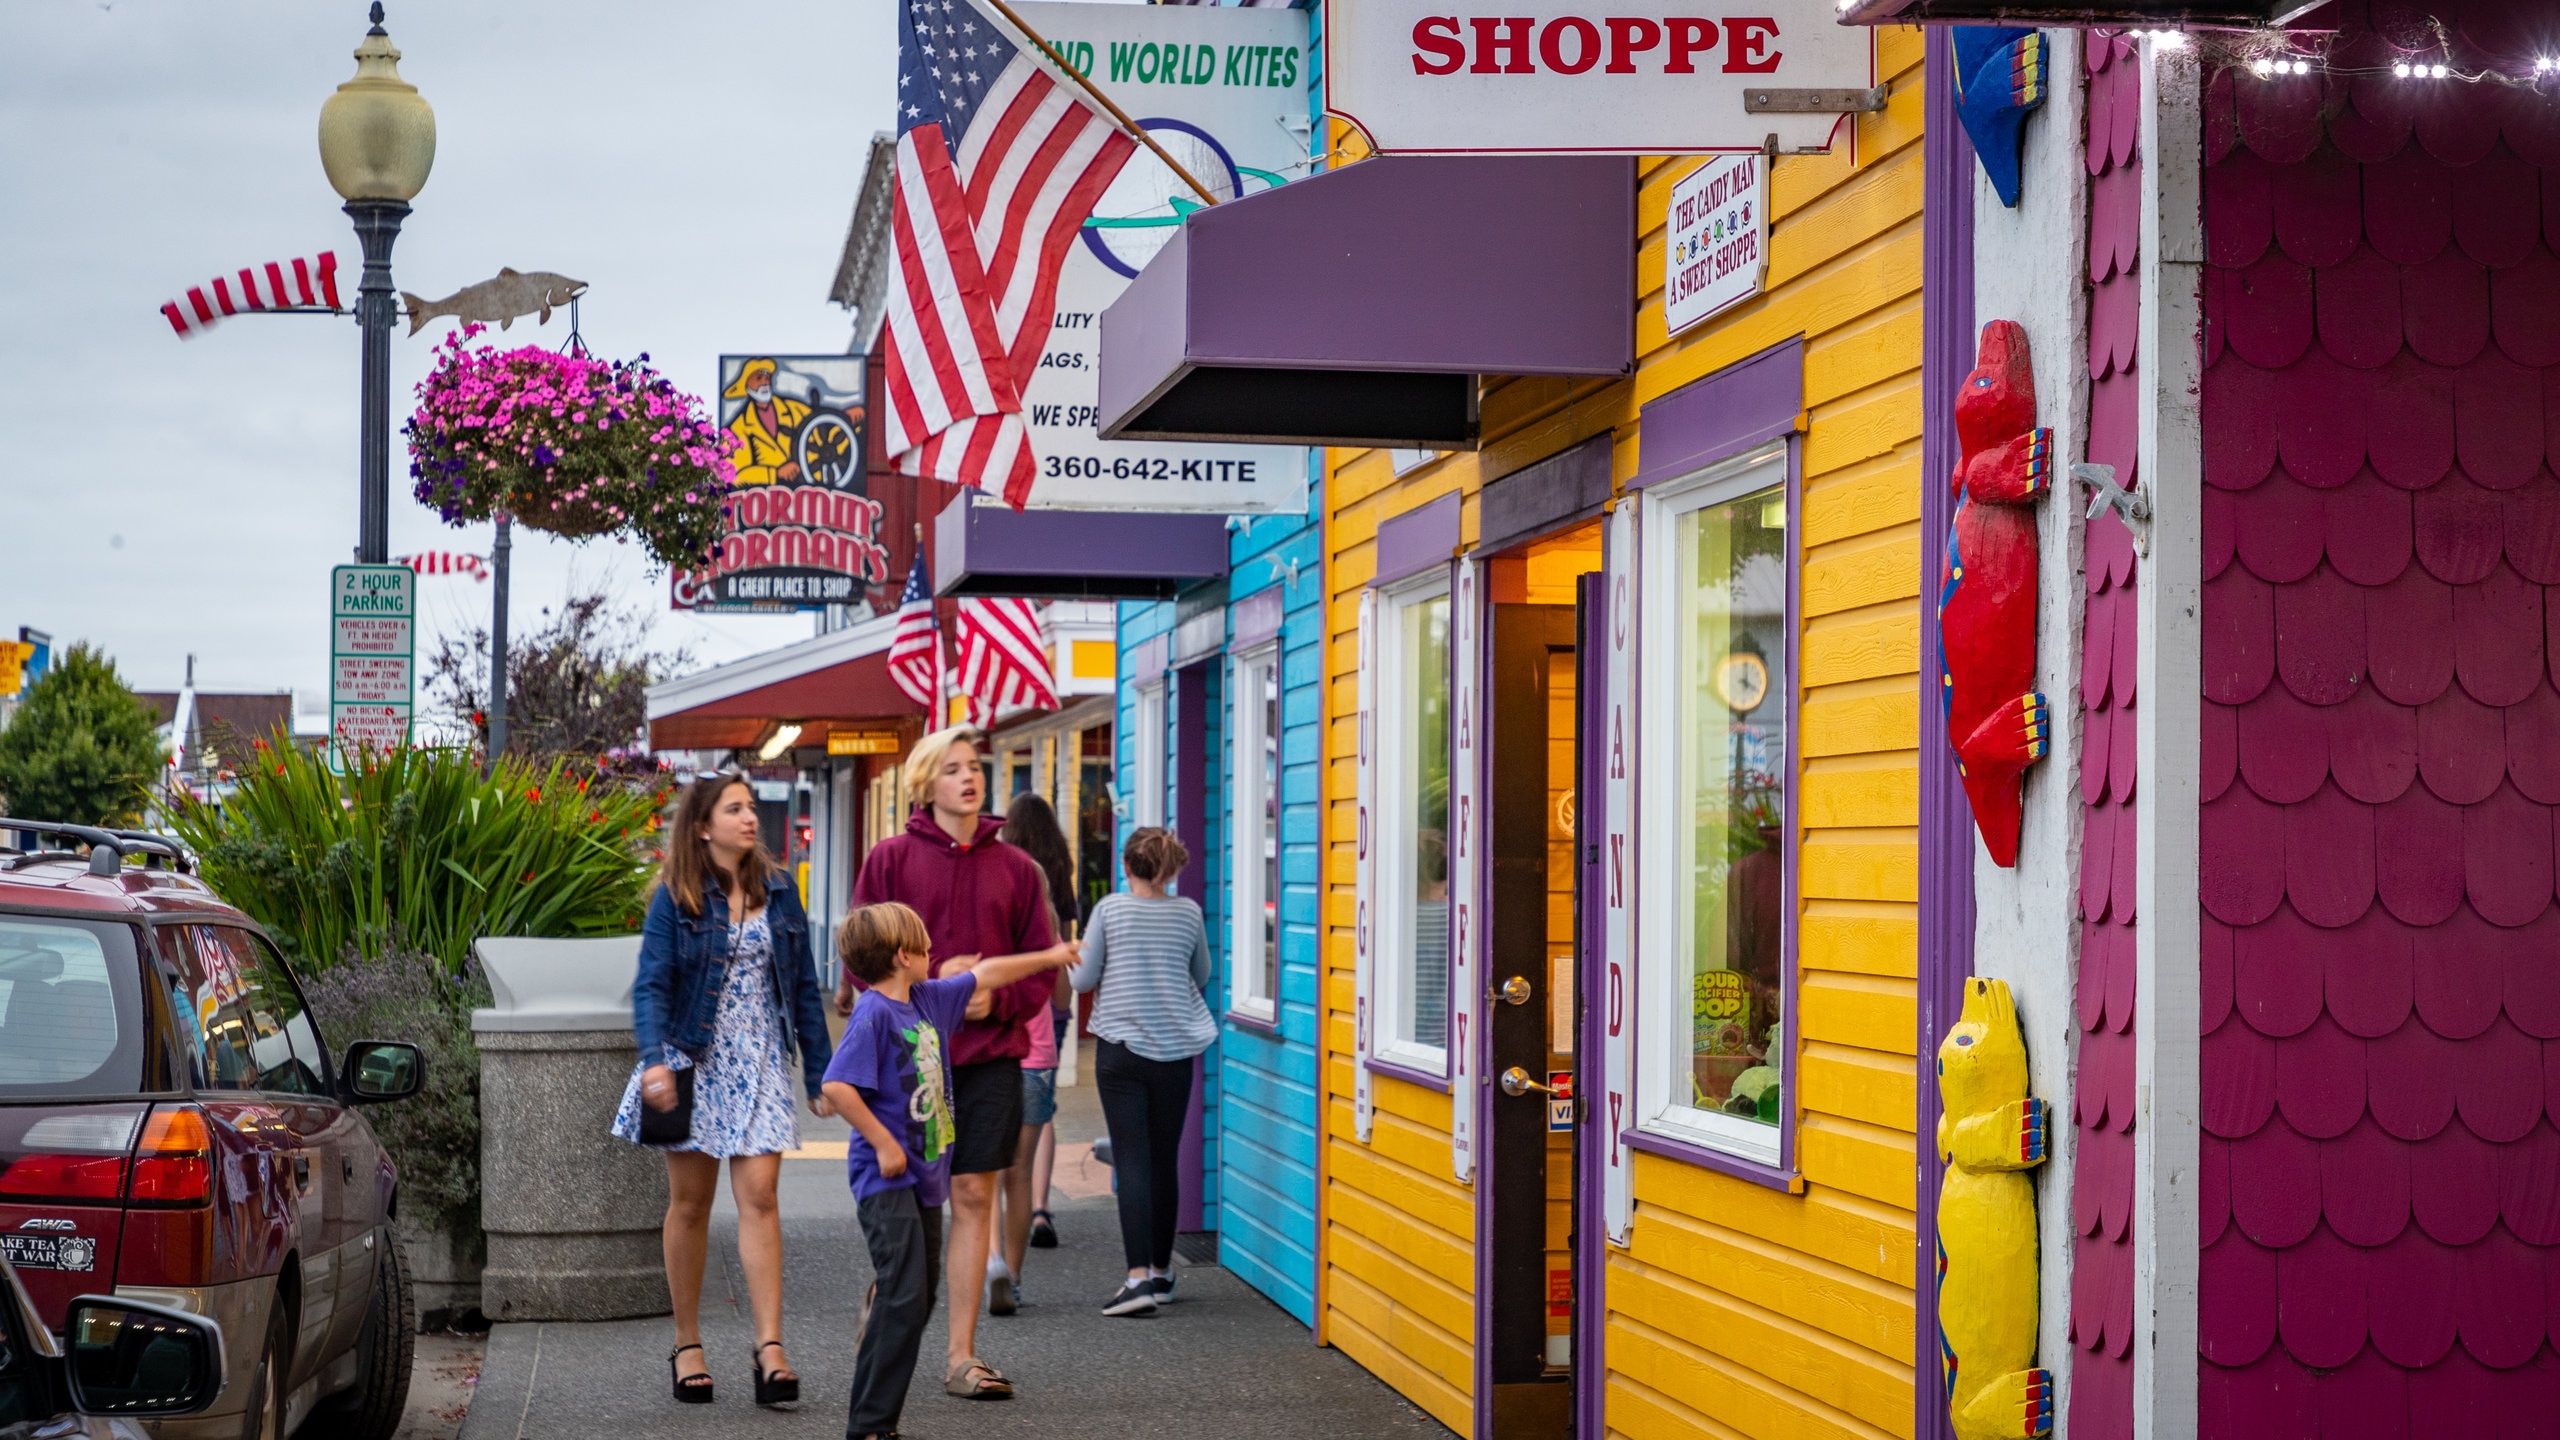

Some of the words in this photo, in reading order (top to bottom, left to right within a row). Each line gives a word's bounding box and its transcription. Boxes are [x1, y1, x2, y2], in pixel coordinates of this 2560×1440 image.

[1411, 16, 1784, 76] SHOPPE
[1110, 42, 1216, 85] WORLD
[1223, 46, 1299, 88] KITES
[1675, 195, 1695, 234] THE
[1697, 171, 1730, 220] CANDY
[1731, 156, 1755, 199] MAN
[1670, 276, 1677, 307] A
[1679, 254, 1714, 301] SWEET
[1715, 228, 1758, 281] SHOPPE
[1055, 313, 1094, 329] LITY
[1040, 352, 1089, 372] AGS,
[1033, 404, 1062, 426] WE
[1045, 456, 1256, 482] 360-642-KITE
[724, 486, 884, 541] TORMIN'
[346, 573, 355, 590] 2
[362, 574, 402, 590] HOUR
[728, 577, 737, 599] A
[738, 577, 771, 599] GREAT
[773, 577, 805, 599] PLACE
[807, 577, 821, 599] TO
[823, 577, 852, 599] SHOP
[343, 595, 404, 611] PARKING
[341, 621, 376, 630] VEHICLES
[378, 621, 398, 630] OVER
[401, 622, 406, 631] 6
[362, 632, 369, 640] IN
[372, 632, 397, 640] HEIGHT
[351, 642, 394, 651] PROHIBITED
[340, 660, 365, 669] STREET
[369, 660, 405, 669] SWEEPING
[344, 671, 357, 679] TOW
[361, 671, 378, 679] AWAY
[381, 671, 401, 680] ZONE
[357, 692, 386, 701] FRIDAYS
[346, 706, 357, 715] NO
[393, 717, 407, 726] AND
[1358, 615, 1369, 1052] FUDGE
[1457, 577, 1472, 1076] TAFFY
[1608, 573, 1627, 1168] CANDY
[1693, 973, 1740, 990] SOUR
[1693, 998, 1740, 1017] POP
[20, 1218, 77, 1231] AWD
[0, 1238, 24, 1250] AKE
[29, 1240, 57, 1252] TEA
[22, 1250, 56, 1262] WAR
